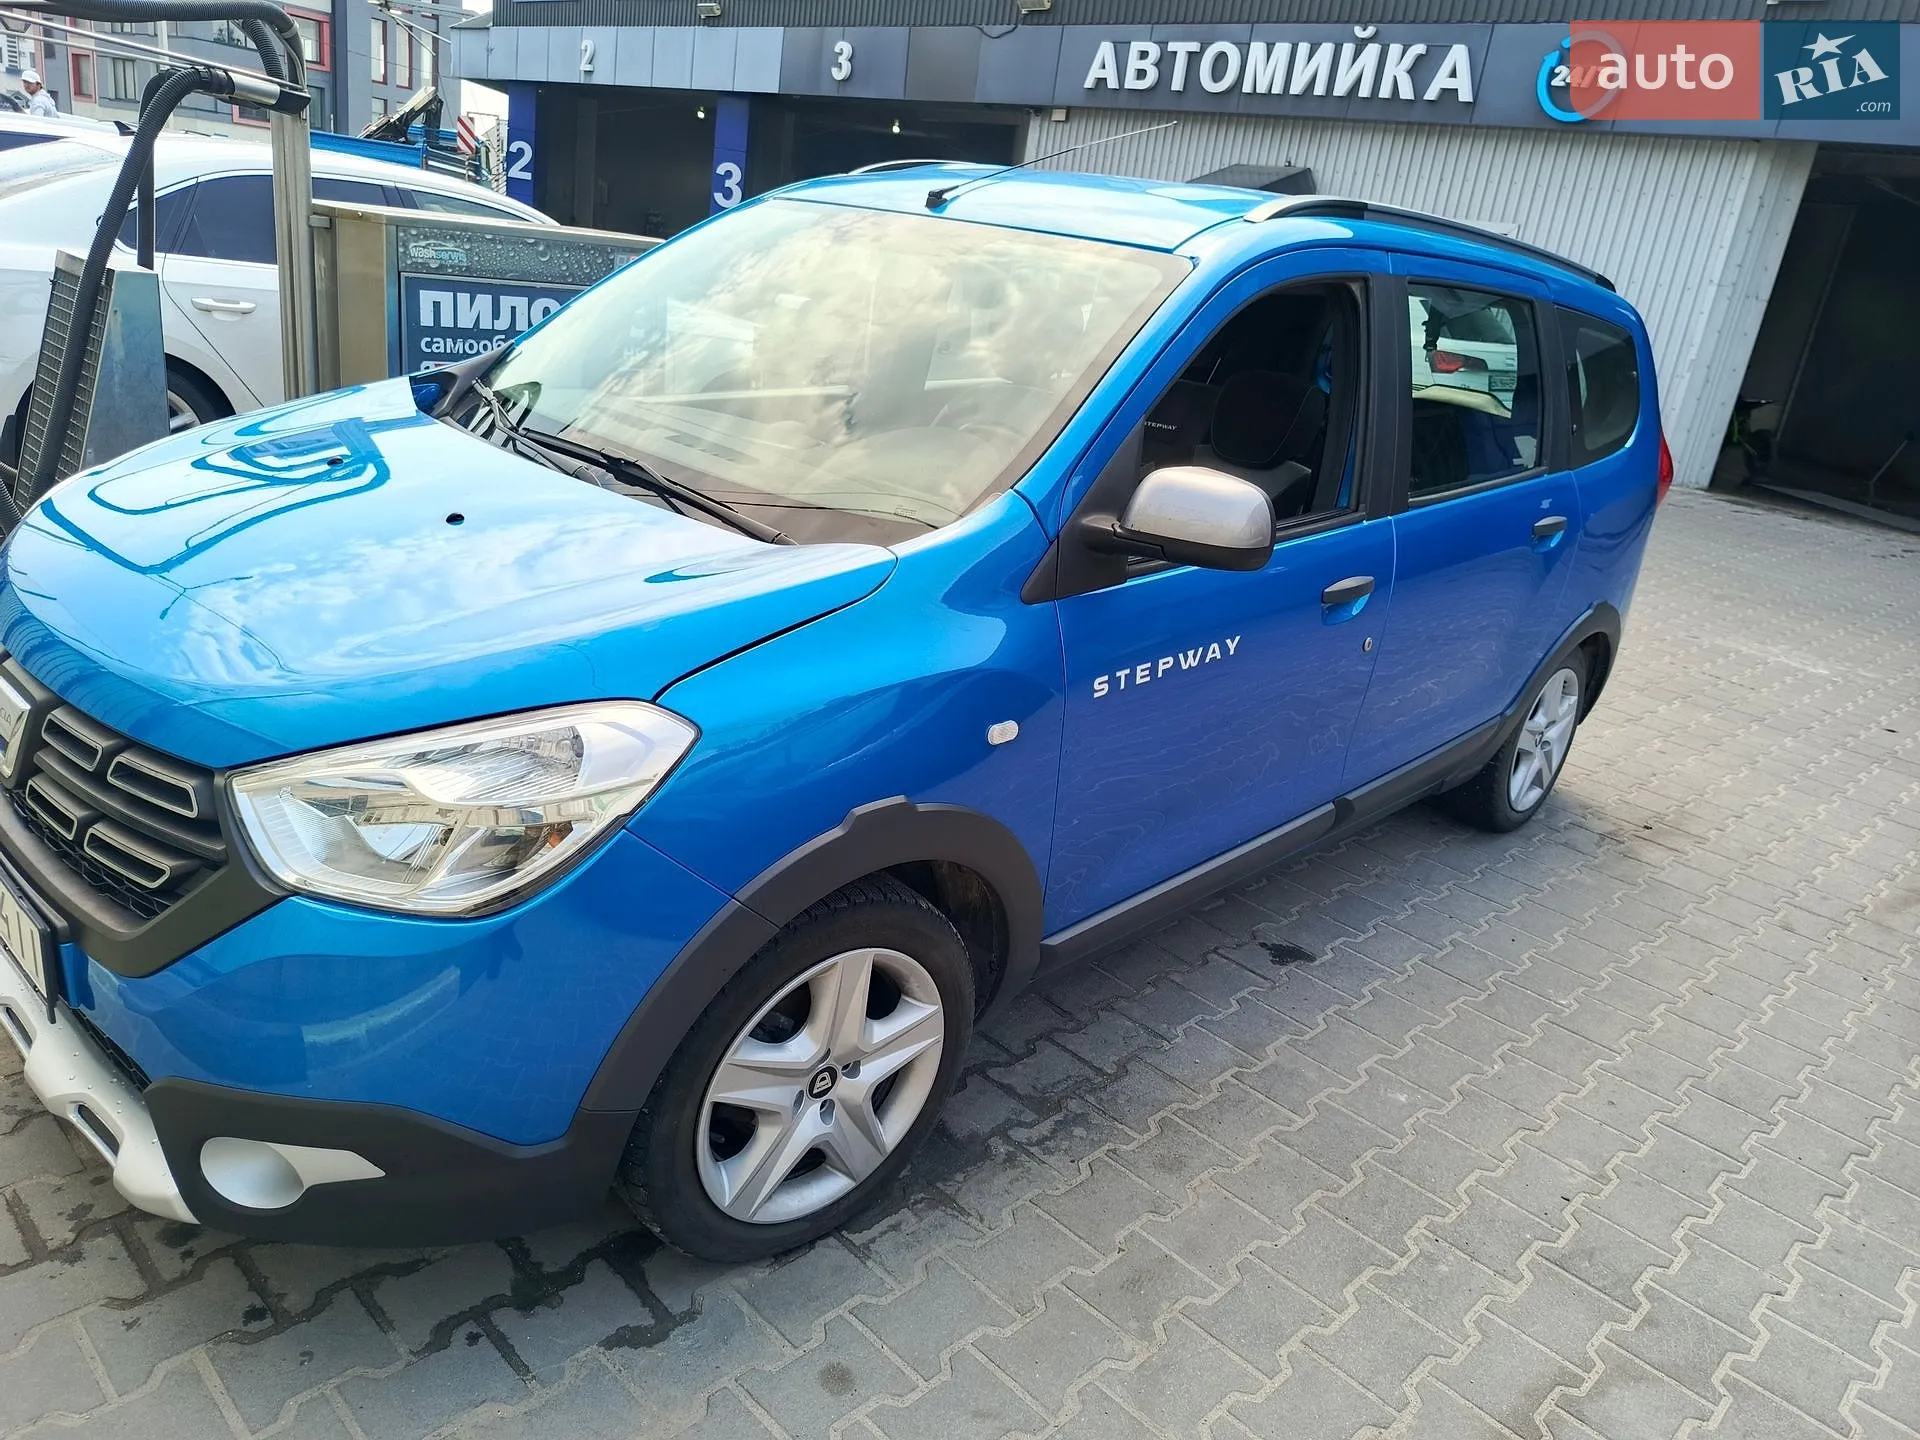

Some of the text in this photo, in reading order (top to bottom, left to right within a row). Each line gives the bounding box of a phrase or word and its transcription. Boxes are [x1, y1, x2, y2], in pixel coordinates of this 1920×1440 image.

[579, 39, 595, 72] 2
[831, 41, 853, 81] 3
[1083, 25, 1474, 103] АВТОМИЙКА
[507, 141, 533, 180] 2
[713, 162, 743, 208] 3
[1093, 635, 1241, 698] STEPWAY
